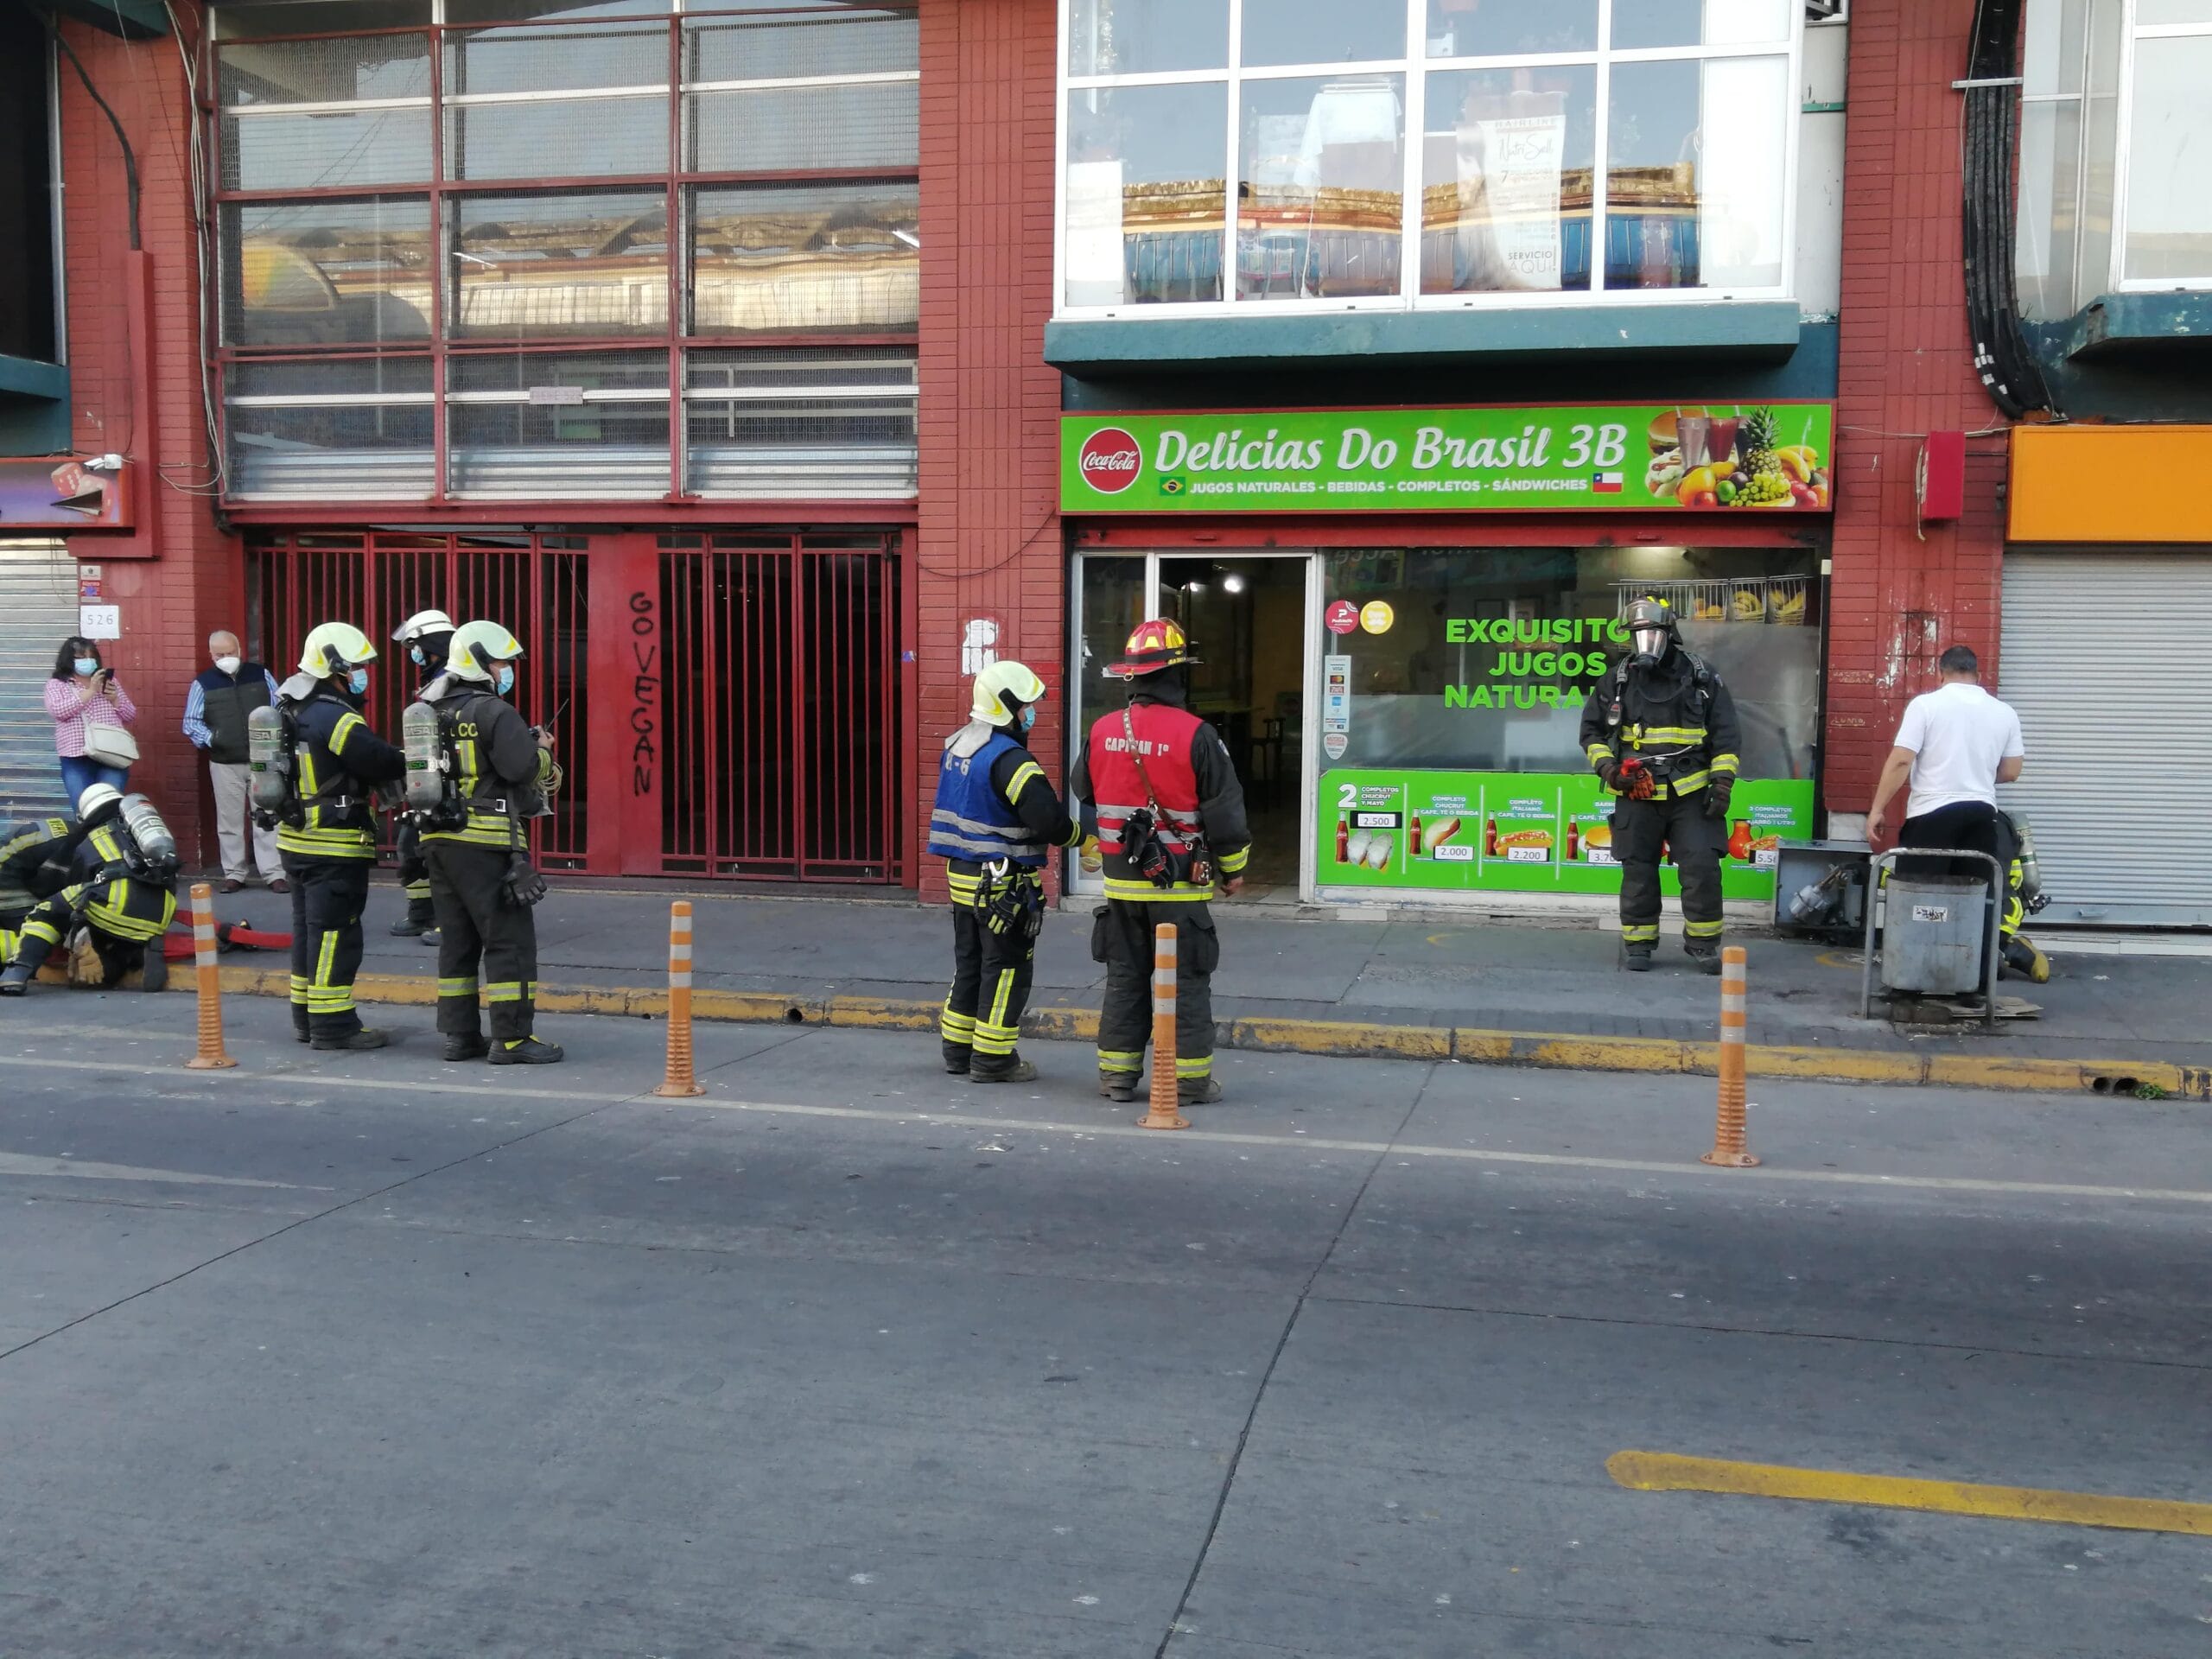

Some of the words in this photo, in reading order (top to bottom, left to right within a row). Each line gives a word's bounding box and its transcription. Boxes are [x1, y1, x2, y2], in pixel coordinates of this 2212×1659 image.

[1508, 250, 1553, 260] SERVICIO
[1337, 427, 1397, 471] Do
[1562, 423, 1628, 469] 3B
[1083, 450, 1138, 471] Coca-Cola
[1190, 482, 1234, 494] JUGOS
[1236, 481, 1316, 493] NATURALES
[1327, 481, 1385, 493] BEBIDAS
[1396, 480, 1480, 493] COMPLETOS
[1492, 477, 1588, 492] SÁNDWICHES
[87, 614, 113, 626] 526
[629, 591, 654, 636] GO
[1488, 651, 1607, 677] JUGOS
[631, 641, 660, 798] VEGAN
[1338, 783, 1357, 808] 2
[1440, 847, 1467, 856] 2.000
[1514, 850, 1541, 860] 2.200
